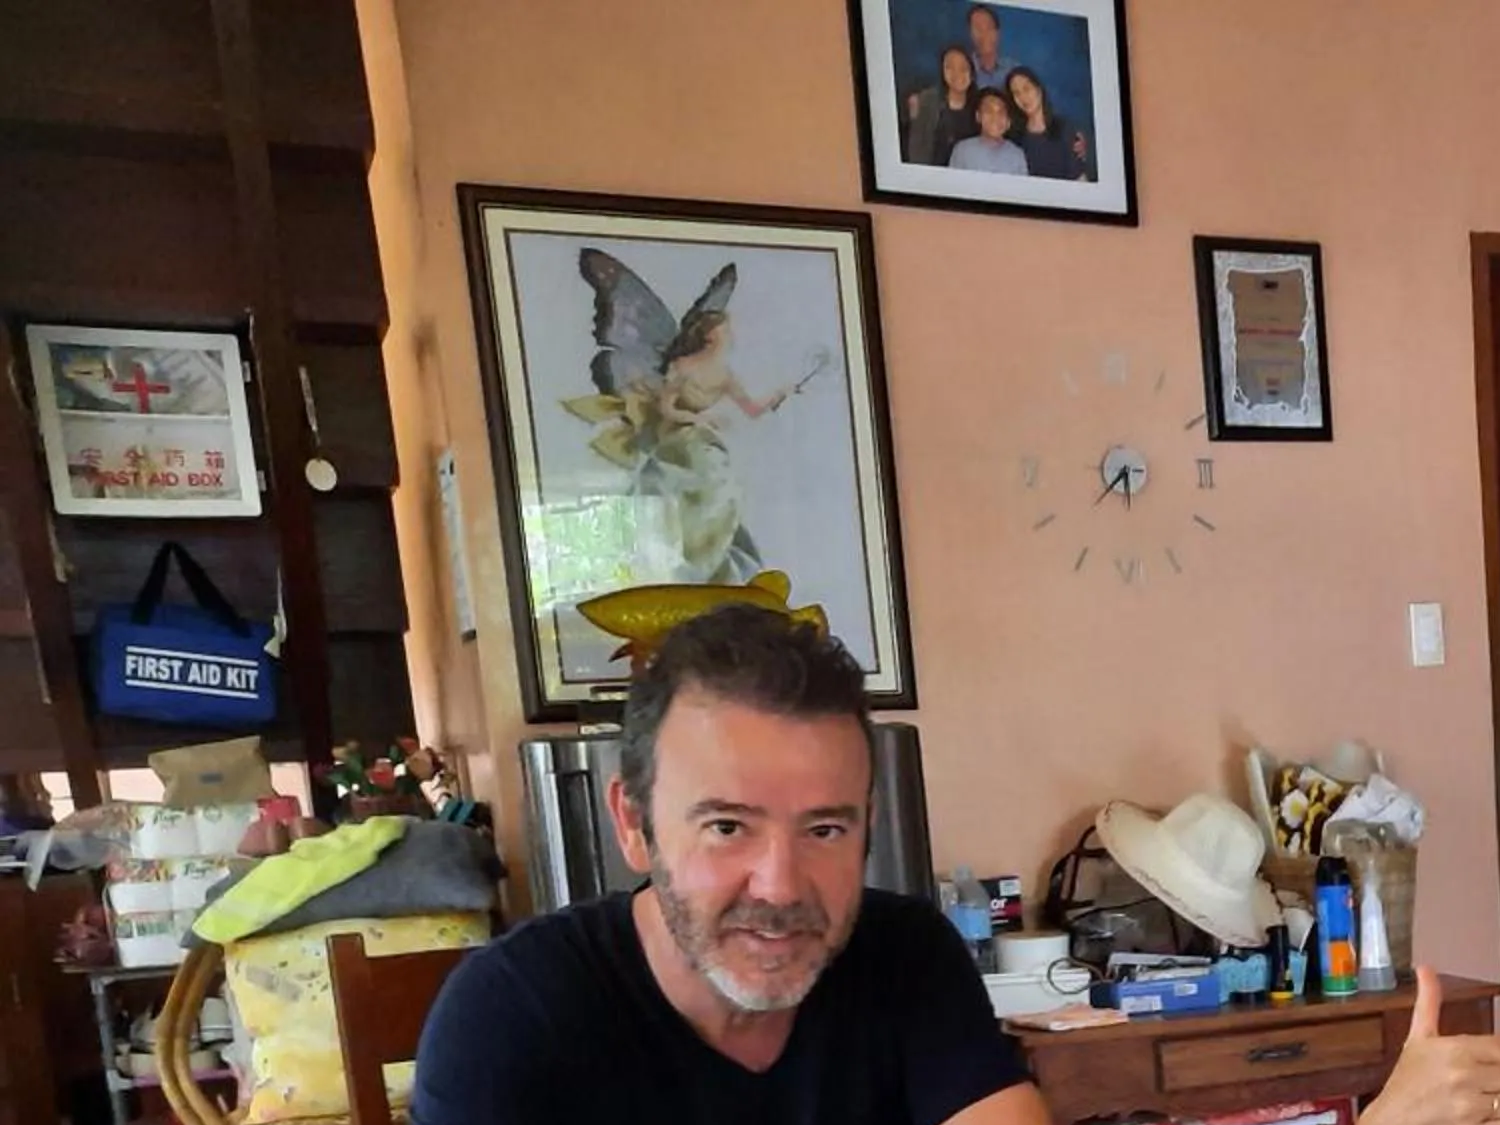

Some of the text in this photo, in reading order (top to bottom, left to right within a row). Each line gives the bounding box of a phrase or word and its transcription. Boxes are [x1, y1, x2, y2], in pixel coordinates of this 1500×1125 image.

[187, 472, 224, 487] BOX
[125, 654, 259, 690] FIRST AID KIT
